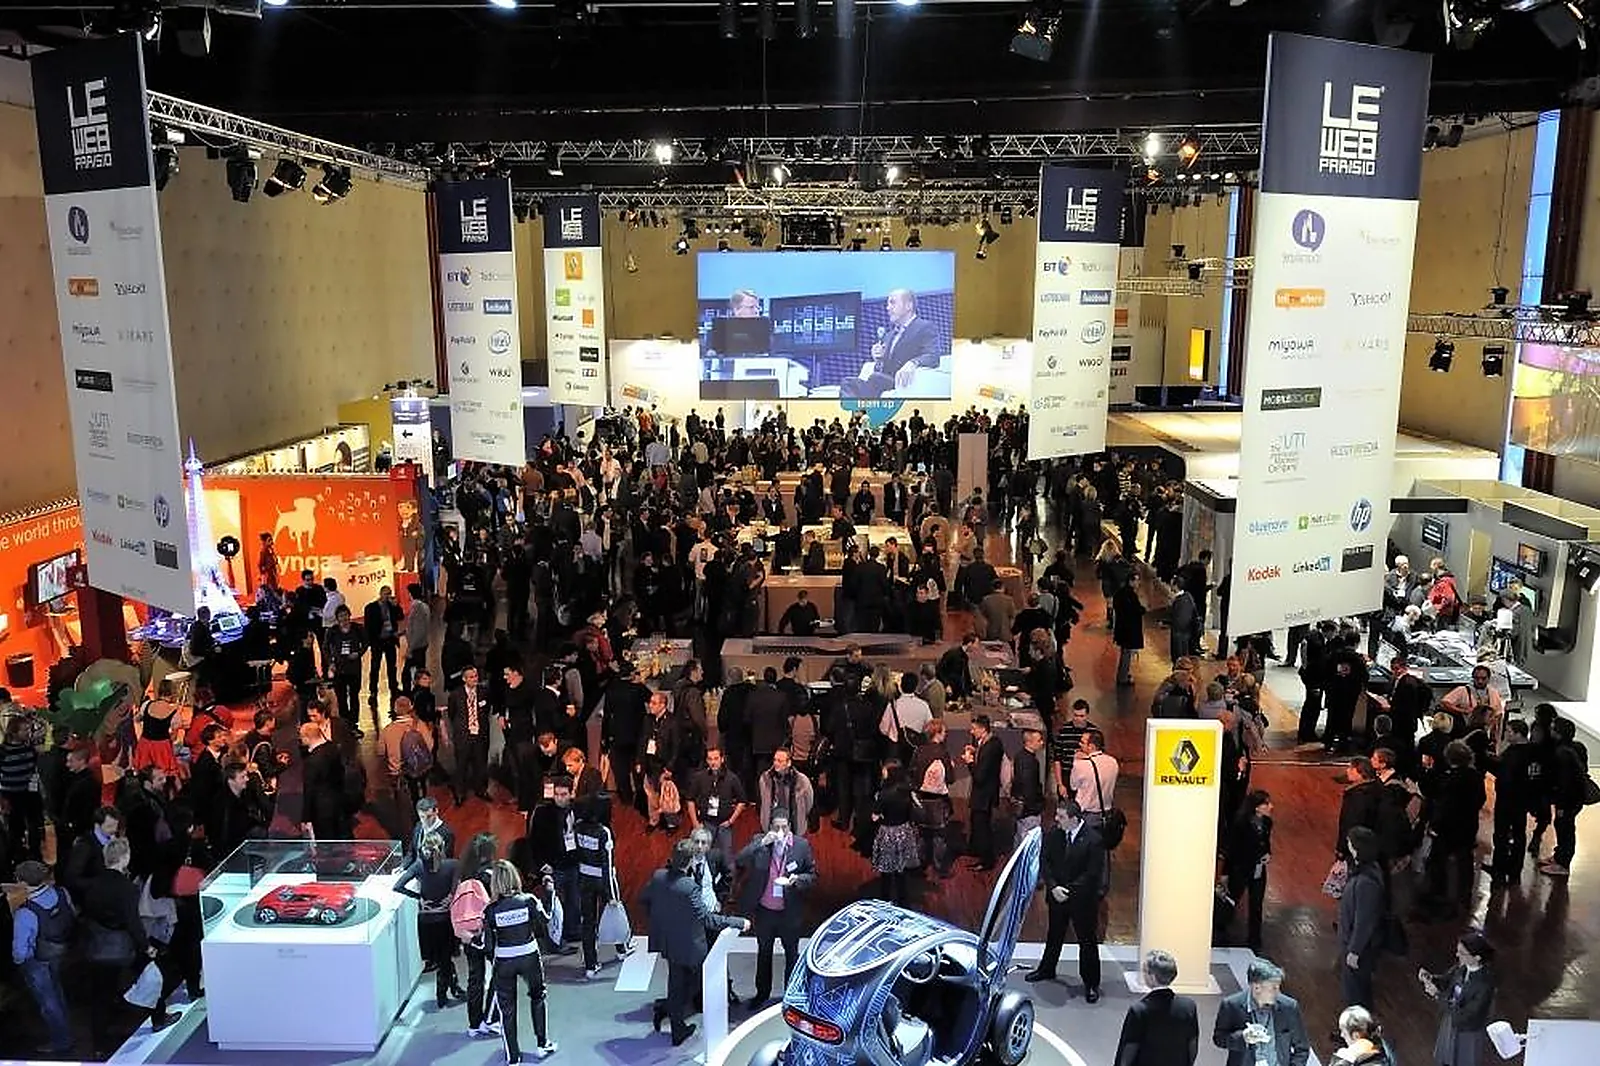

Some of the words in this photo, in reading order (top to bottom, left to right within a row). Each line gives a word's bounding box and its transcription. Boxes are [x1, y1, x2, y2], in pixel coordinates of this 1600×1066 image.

[1322, 81, 1381, 130] LE
[71, 124, 111, 155] WEB
[1320, 128, 1378, 160] WEB
[461, 199, 487, 220] LE
[1068, 187, 1098, 209] LE
[1043, 262, 1057, 272] BT
[1351, 503, 1371, 532] hp
[13, 521, 50, 546] world
[1246, 565, 1281, 581] Kodak
[1160, 775, 1208, 785] RENAULT
